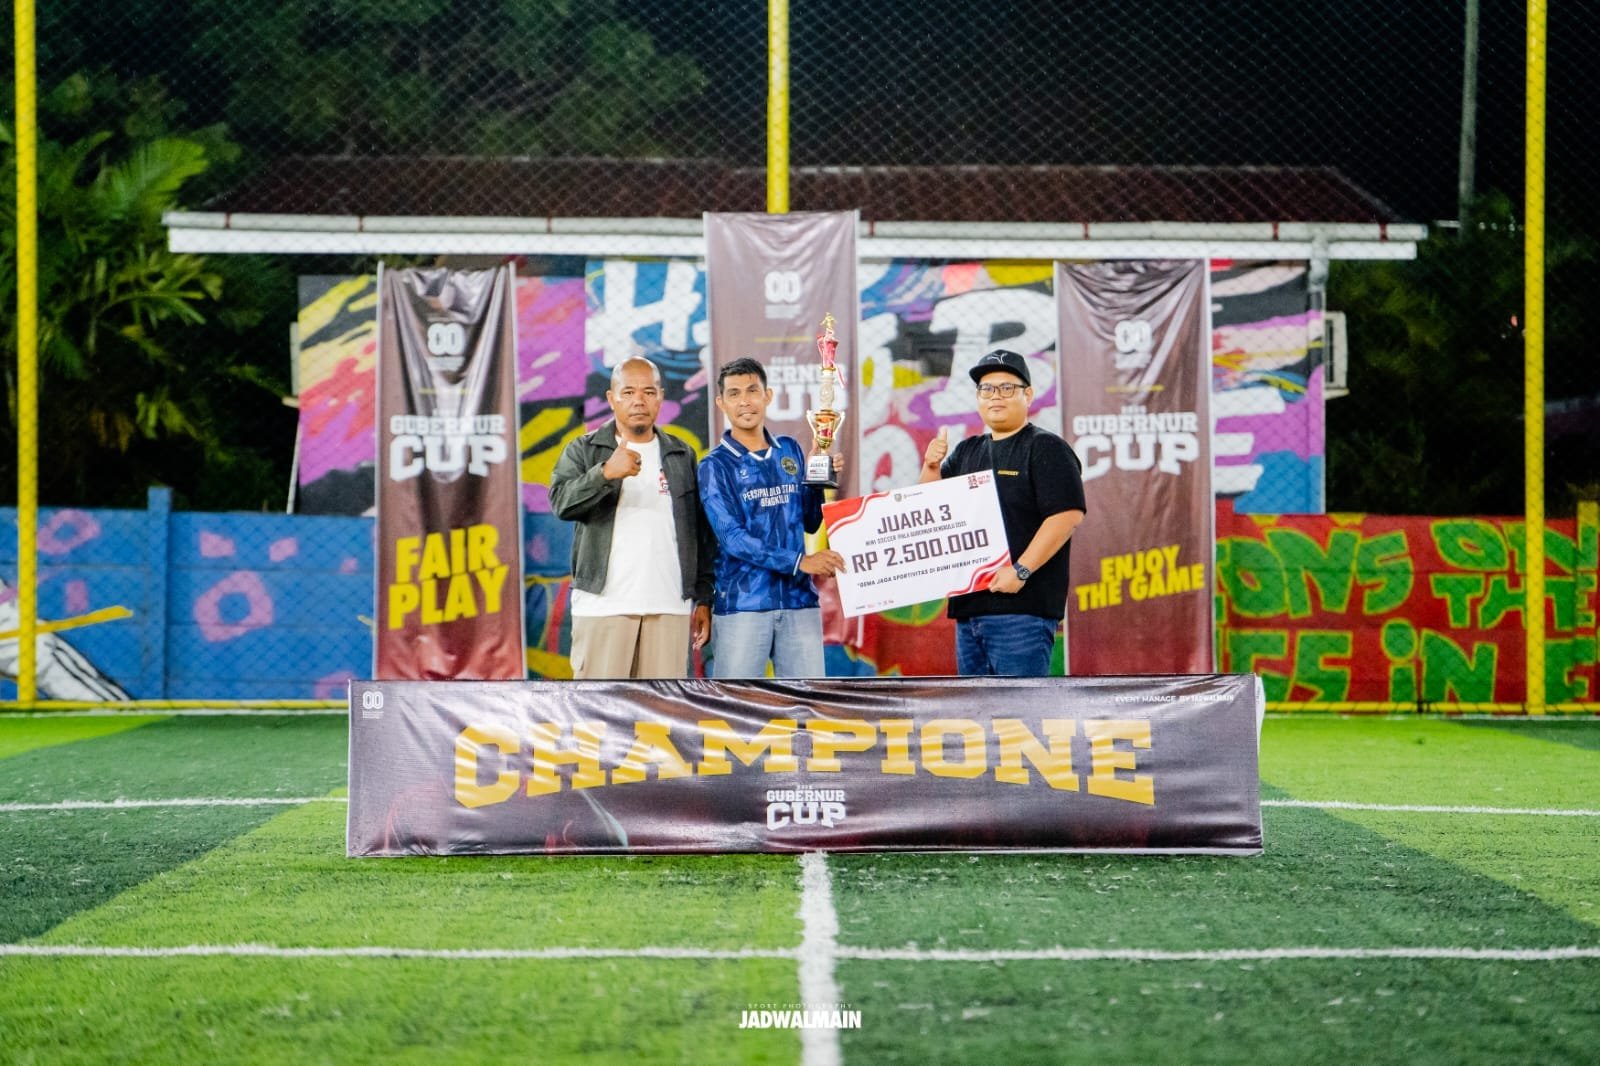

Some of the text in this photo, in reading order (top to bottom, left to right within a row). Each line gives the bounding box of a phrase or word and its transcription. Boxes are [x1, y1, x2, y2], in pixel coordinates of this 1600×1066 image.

[1073, 412, 1198, 435] GUBERNUR
[389, 434, 508, 481] CUP
[1073, 433, 1200, 482] CUP
[878, 504, 952, 534] JUARA 3
[396, 523, 501, 583] FAIR
[852, 528, 989, 573] RP 2.500.000
[1100, 544, 1181, 581] ENJOY
[388, 565, 509, 630] PLAY
[1075, 563, 1205, 612] THE GAME
[454, 718, 1155, 809] CHAMPIONE
[766, 789, 845, 802] GUBERNUR
[766, 801, 846, 831] CUP
